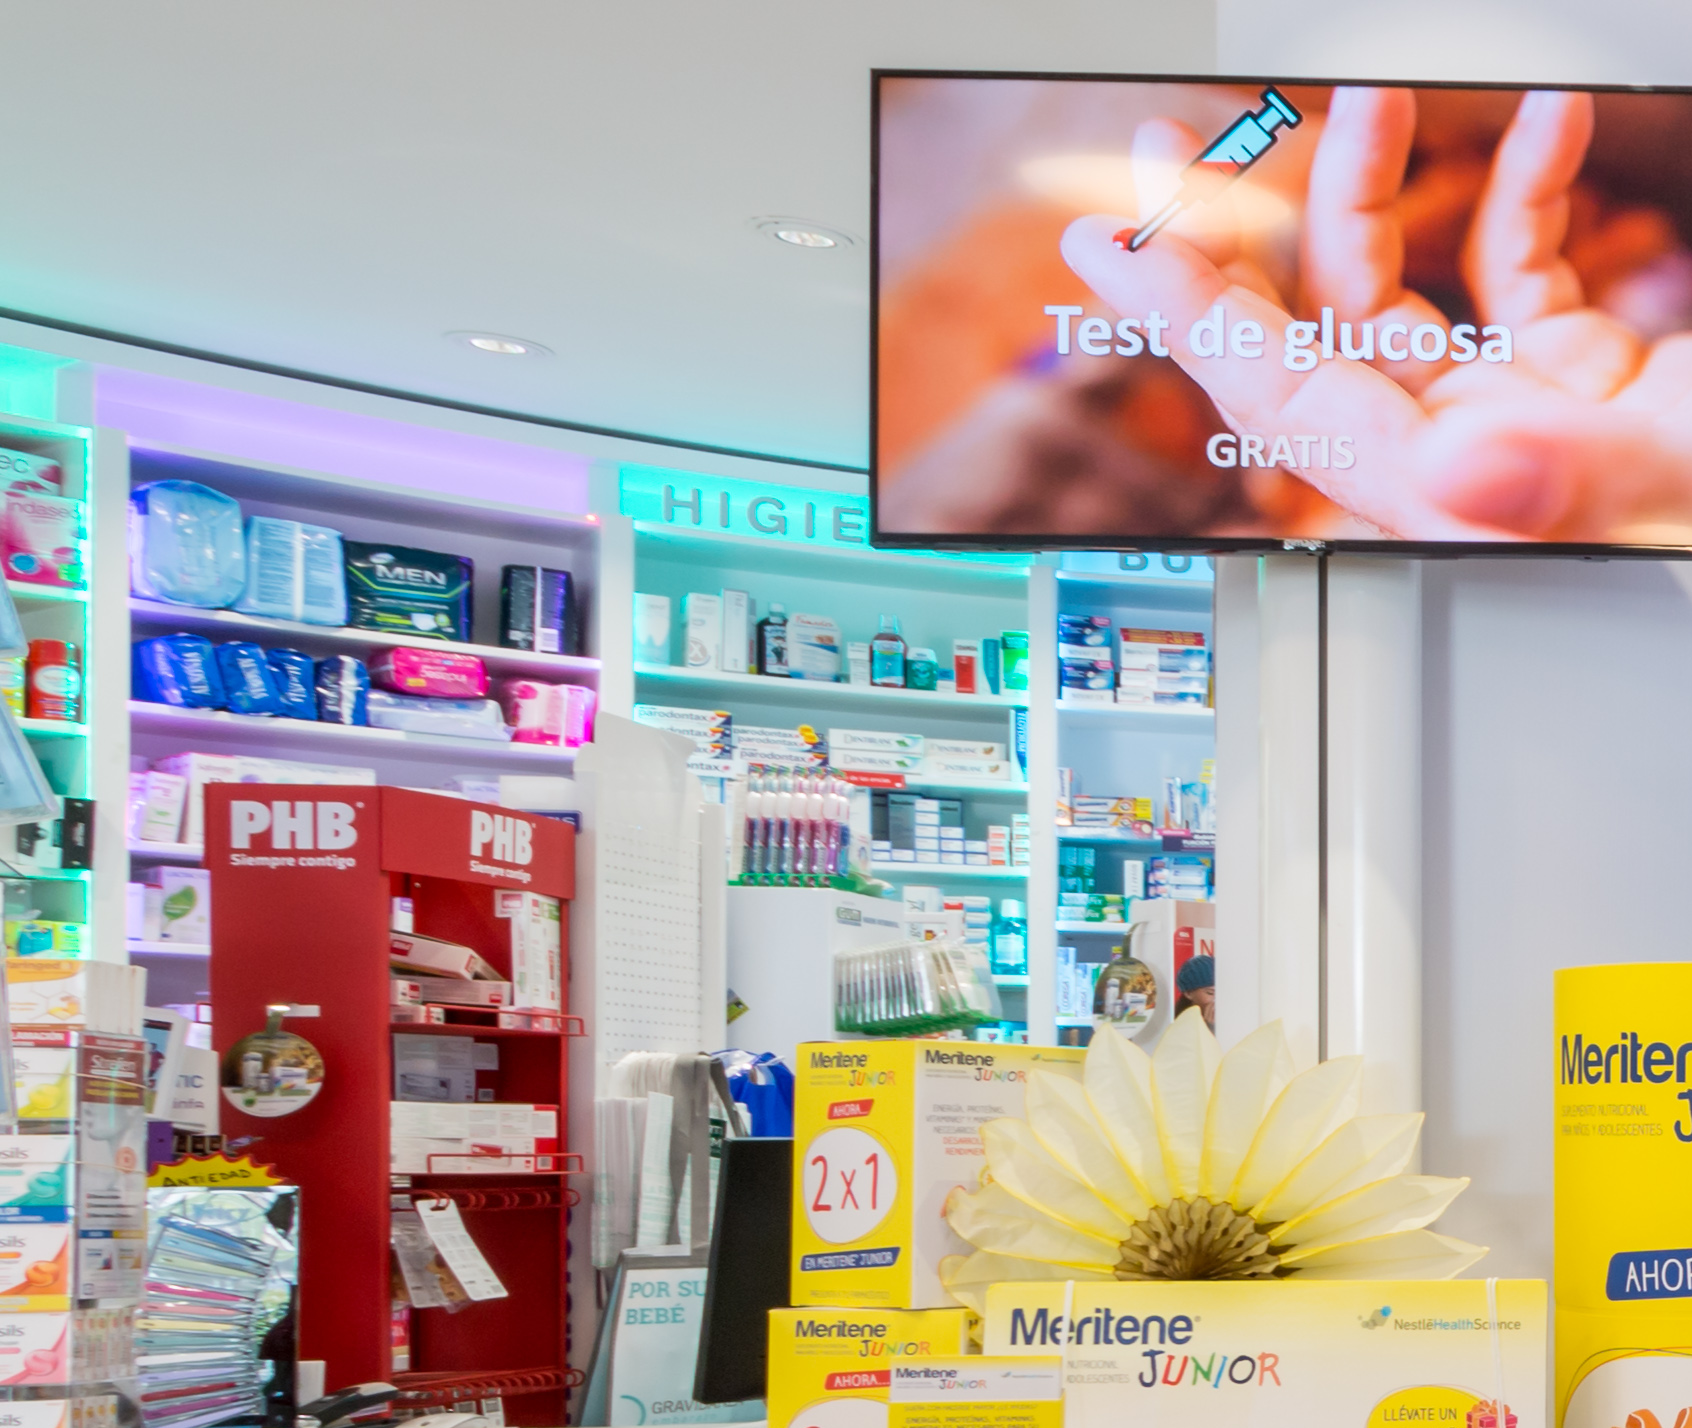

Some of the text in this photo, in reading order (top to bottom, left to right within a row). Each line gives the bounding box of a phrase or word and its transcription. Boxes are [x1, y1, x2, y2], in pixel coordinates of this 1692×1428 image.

[1044, 304, 1513, 371] Test de glucosa
[1206, 433, 1355, 470] GRATIS
[663, 484, 864, 543] HIGIE
[231, 801, 357, 851] PHB
[470, 810, 532, 867] PHB
[231, 853, 356, 871] Siempre contigo
[629, 1281, 672, 1299] POR
[626, 1305, 685, 1324] BEBÉ
[1010, 1308, 1193, 1346] Meritene
[1139, 1349, 1282, 1388] JUNIOR
[1383, 1406, 1433, 1423] LLÉVATE
